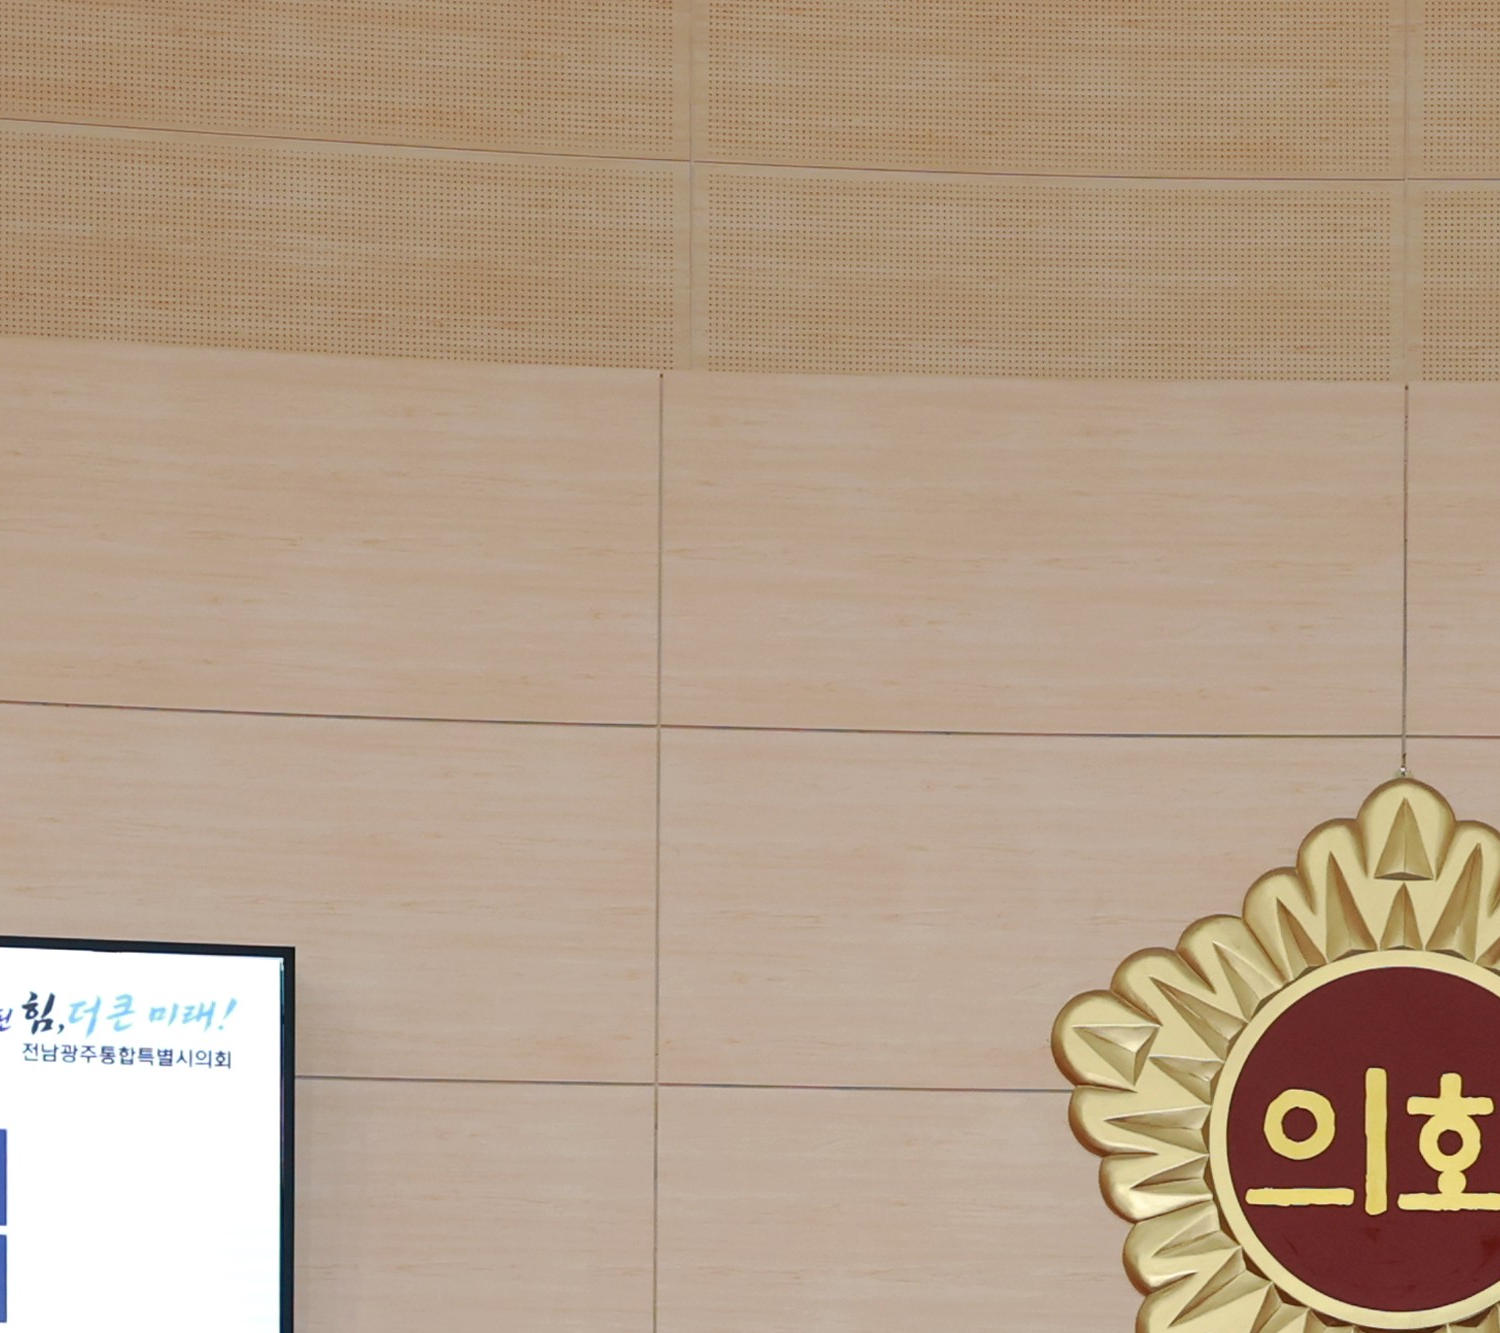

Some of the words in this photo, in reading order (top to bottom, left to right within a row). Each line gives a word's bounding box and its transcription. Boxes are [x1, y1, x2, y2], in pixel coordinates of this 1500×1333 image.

[22, 991, 64, 1034] 힘,
[68, 995, 102, 1038] 더
[106, 994, 135, 1032] 큰
[149, 998, 238, 1032] 미래!
[22, 1043, 232, 1069] 전남광주통합특별시의회
